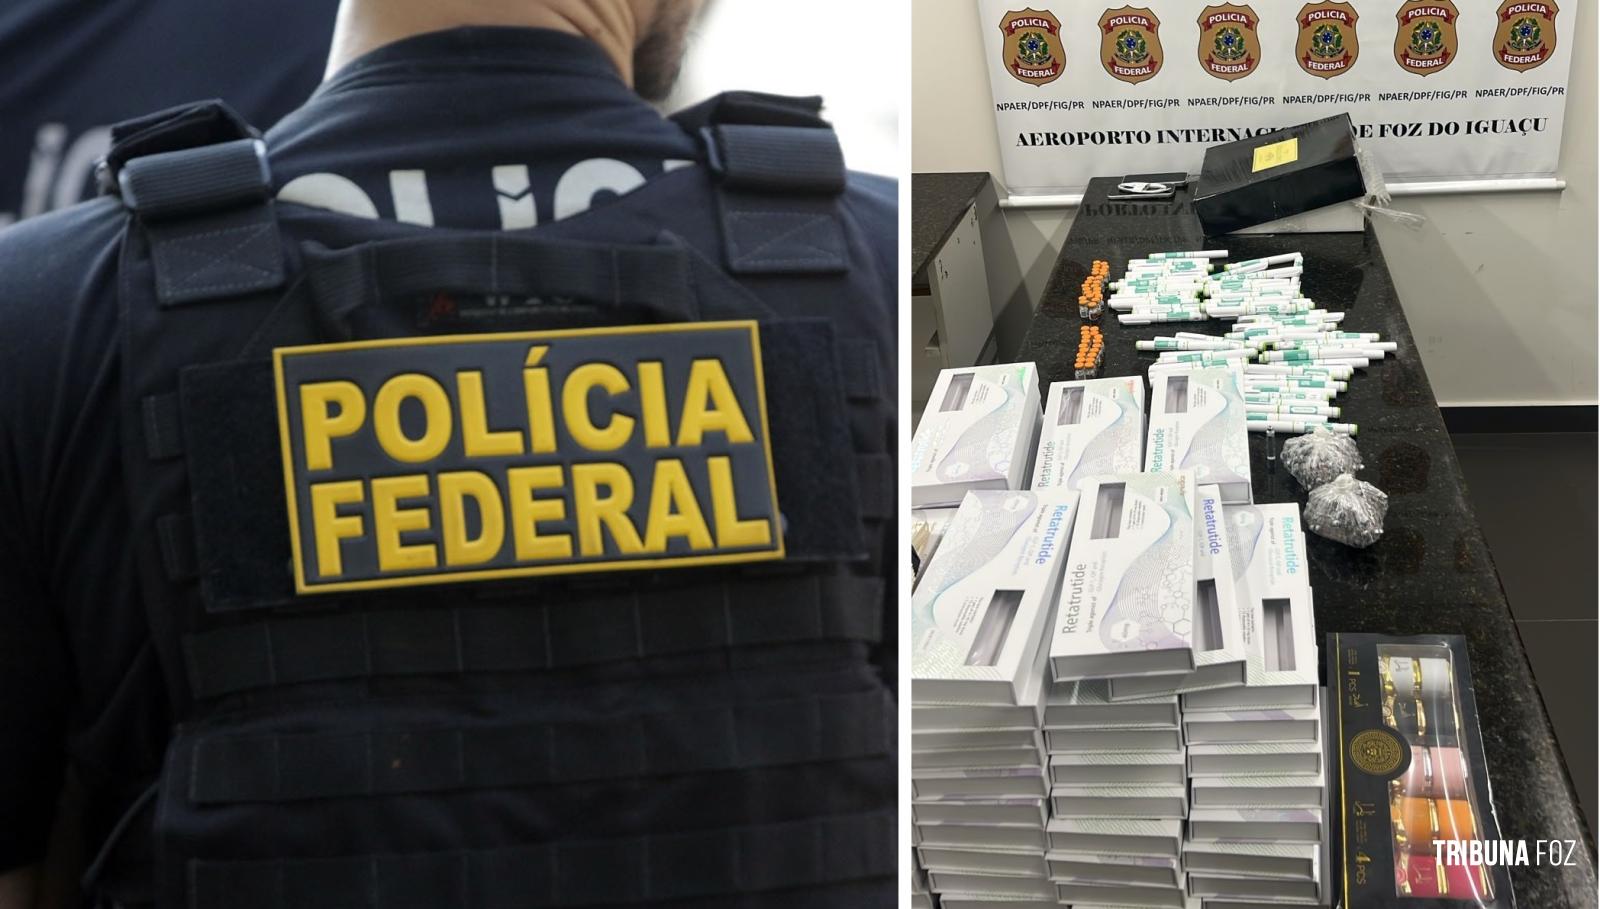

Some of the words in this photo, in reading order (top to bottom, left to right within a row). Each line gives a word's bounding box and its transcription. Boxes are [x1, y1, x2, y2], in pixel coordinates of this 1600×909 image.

[1408, 7, 1447, 19] POLICIA
[1508, 3, 1547, 15] POLICIA
[1110, 15, 1149, 27] POLICIA
[1209, 13, 1248, 24] POLICIA
[1308, 10, 1347, 22] POLICIA
[1011, 17, 1050, 30] POLICIA
[1406, 57, 1444, 68] FEDERAL
[1504, 53, 1542, 64] FEDERAL
[1114, 65, 1152, 76] FEDERAL
[1211, 63, 1249, 74] FEDERAL
[1308, 60, 1346, 71] FEDERAL
[1017, 67, 1055, 78] FEDERAL
[996, 100, 1085, 112] NPAER/DPF/FIG/PR
[1092, 98, 1180, 110] NPAER/DPF/FIG/PR
[1187, 96, 1275, 108] NPAER/DPF/FIG/PR
[1282, 93, 1371, 105] NPAER/DPF/FIG/PR
[1378, 90, 1468, 102] NPAER/DPF/FIG/PR
[1475, 86, 1565, 99] NPAER/DPF/FIG/PR
[1016, 129, 1151, 147] AEROPORTO
[1156, 127, 1285, 145] INTERNAC
[1378, 122, 1423, 138] FOZ
[1427, 121, 1460, 136] DO
[1465, 117, 1549, 137] IGUAÇU
[300, 345, 755, 471] POLÍCIA
[1151, 428, 1165, 473] Retatrutide
[1037, 441, 1056, 487] Retatrutide
[310, 456, 771, 577] FEDERAL
[1203, 498, 1223, 555] Retatrutide
[1036, 505, 1068, 565] Retatrutide
[1281, 516, 1300, 574] Retatrutide
[1062, 563, 1087, 634] Retatrutide
